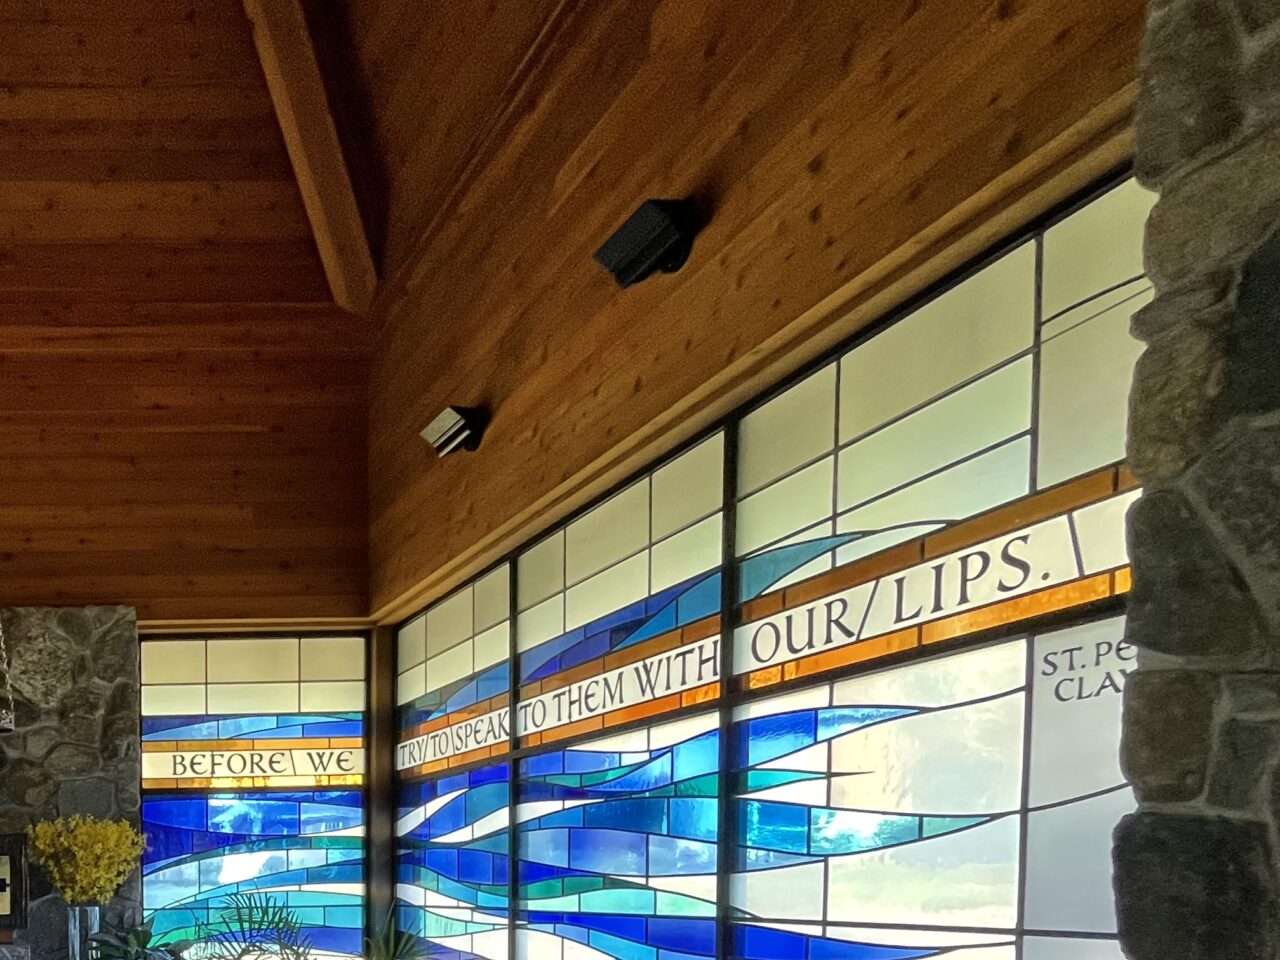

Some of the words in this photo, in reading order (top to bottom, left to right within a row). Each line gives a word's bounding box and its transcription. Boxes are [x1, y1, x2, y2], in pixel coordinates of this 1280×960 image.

[400, 738, 424, 767] TRY
[429, 733, 449, 758] TO
[455, 710, 510, 751] SPEAK
[519, 701, 547, 732] TO
[553, 671, 624, 722] THEM
[634, 640, 719, 698] WITH
[751, 597, 856, 664] OUR
[893, 533, 1051, 625] LIPS.
[1041, 646, 1087, 676] ST.
[1054, 669, 1127, 702] CLA
[171, 752, 287, 776] BEFORE
[306, 750, 355, 772] WE
